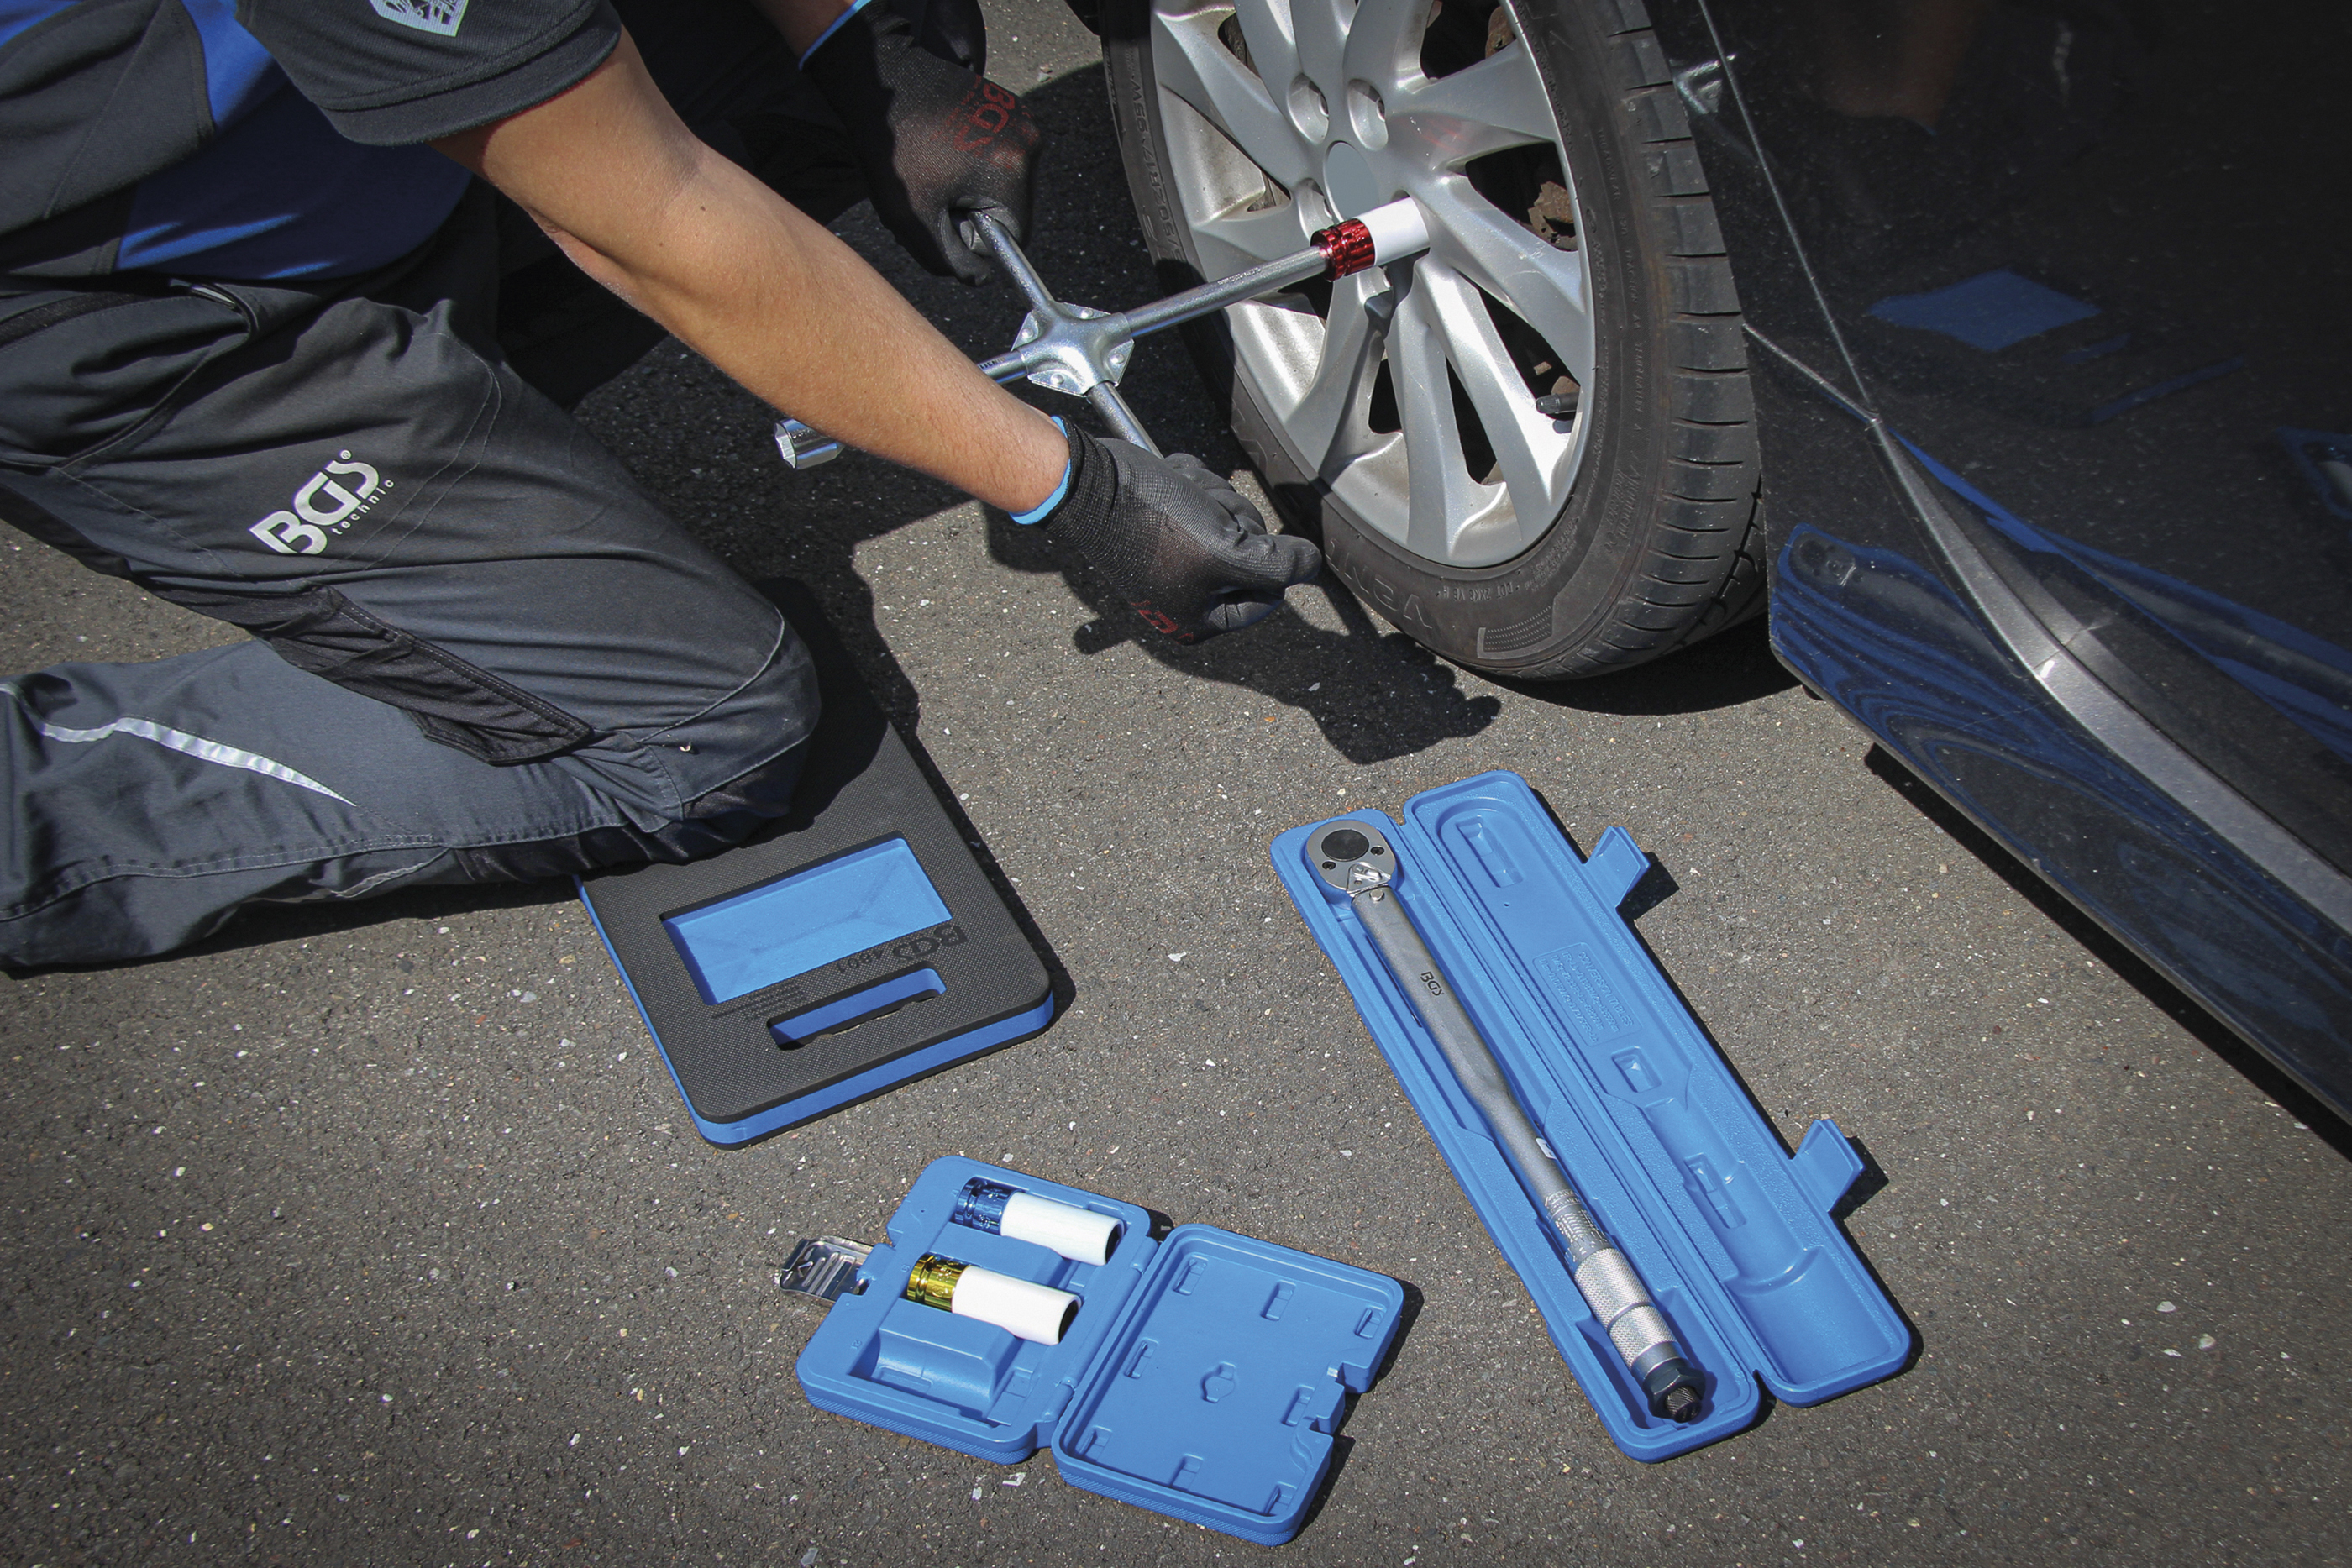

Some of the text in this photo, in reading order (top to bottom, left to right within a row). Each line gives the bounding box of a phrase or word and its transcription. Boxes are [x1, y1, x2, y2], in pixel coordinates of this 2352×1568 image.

[249, 460, 380, 555] BGS
[330, 479, 395, 536] technic
[1496, 581, 1513, 599] DOT
[891, 923, 968, 962] BGS
[1420, 970, 1443, 997] BGS
[1608, 996, 1635, 1027] TABLES
